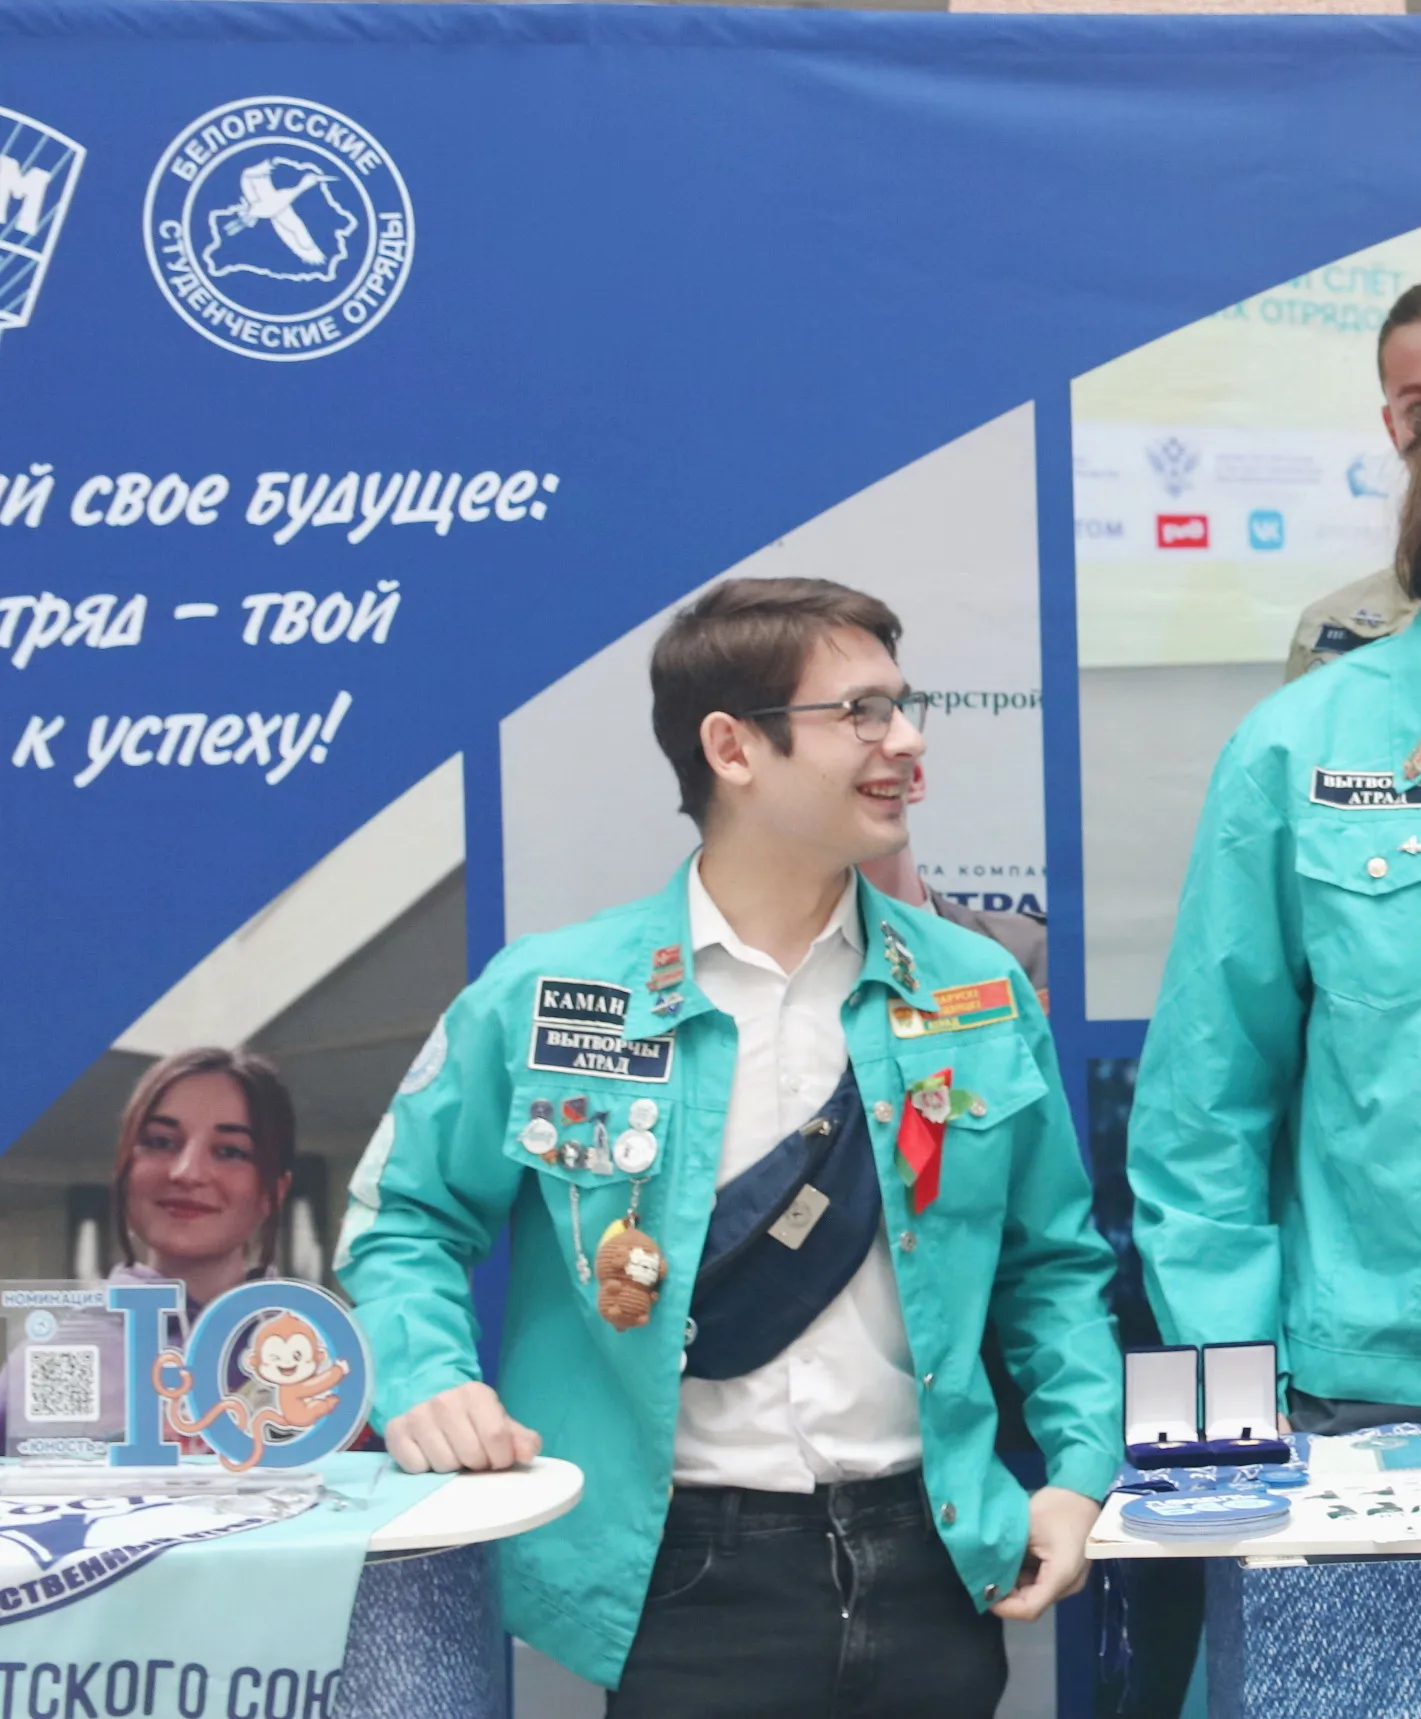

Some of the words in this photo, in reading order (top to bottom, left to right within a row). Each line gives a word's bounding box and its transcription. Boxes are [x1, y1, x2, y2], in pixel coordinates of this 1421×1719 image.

[171, 106, 383, 183] БЕЛОРУССКИЕ
[158, 219, 341, 348] СТУДЕНЧЕСКИЕ
[342, 211, 404, 325] ОТРЯДЫ
[241, 580, 401, 646] твой
[73, 690, 353, 789] успеху!
[958, 864, 1046, 878] КОМПА
[542, 989, 628, 1019] КАМАН
[546, 1030, 661, 1059] ВЫТВОРЧЫ
[572, 1052, 631, 1075] АТРАД
